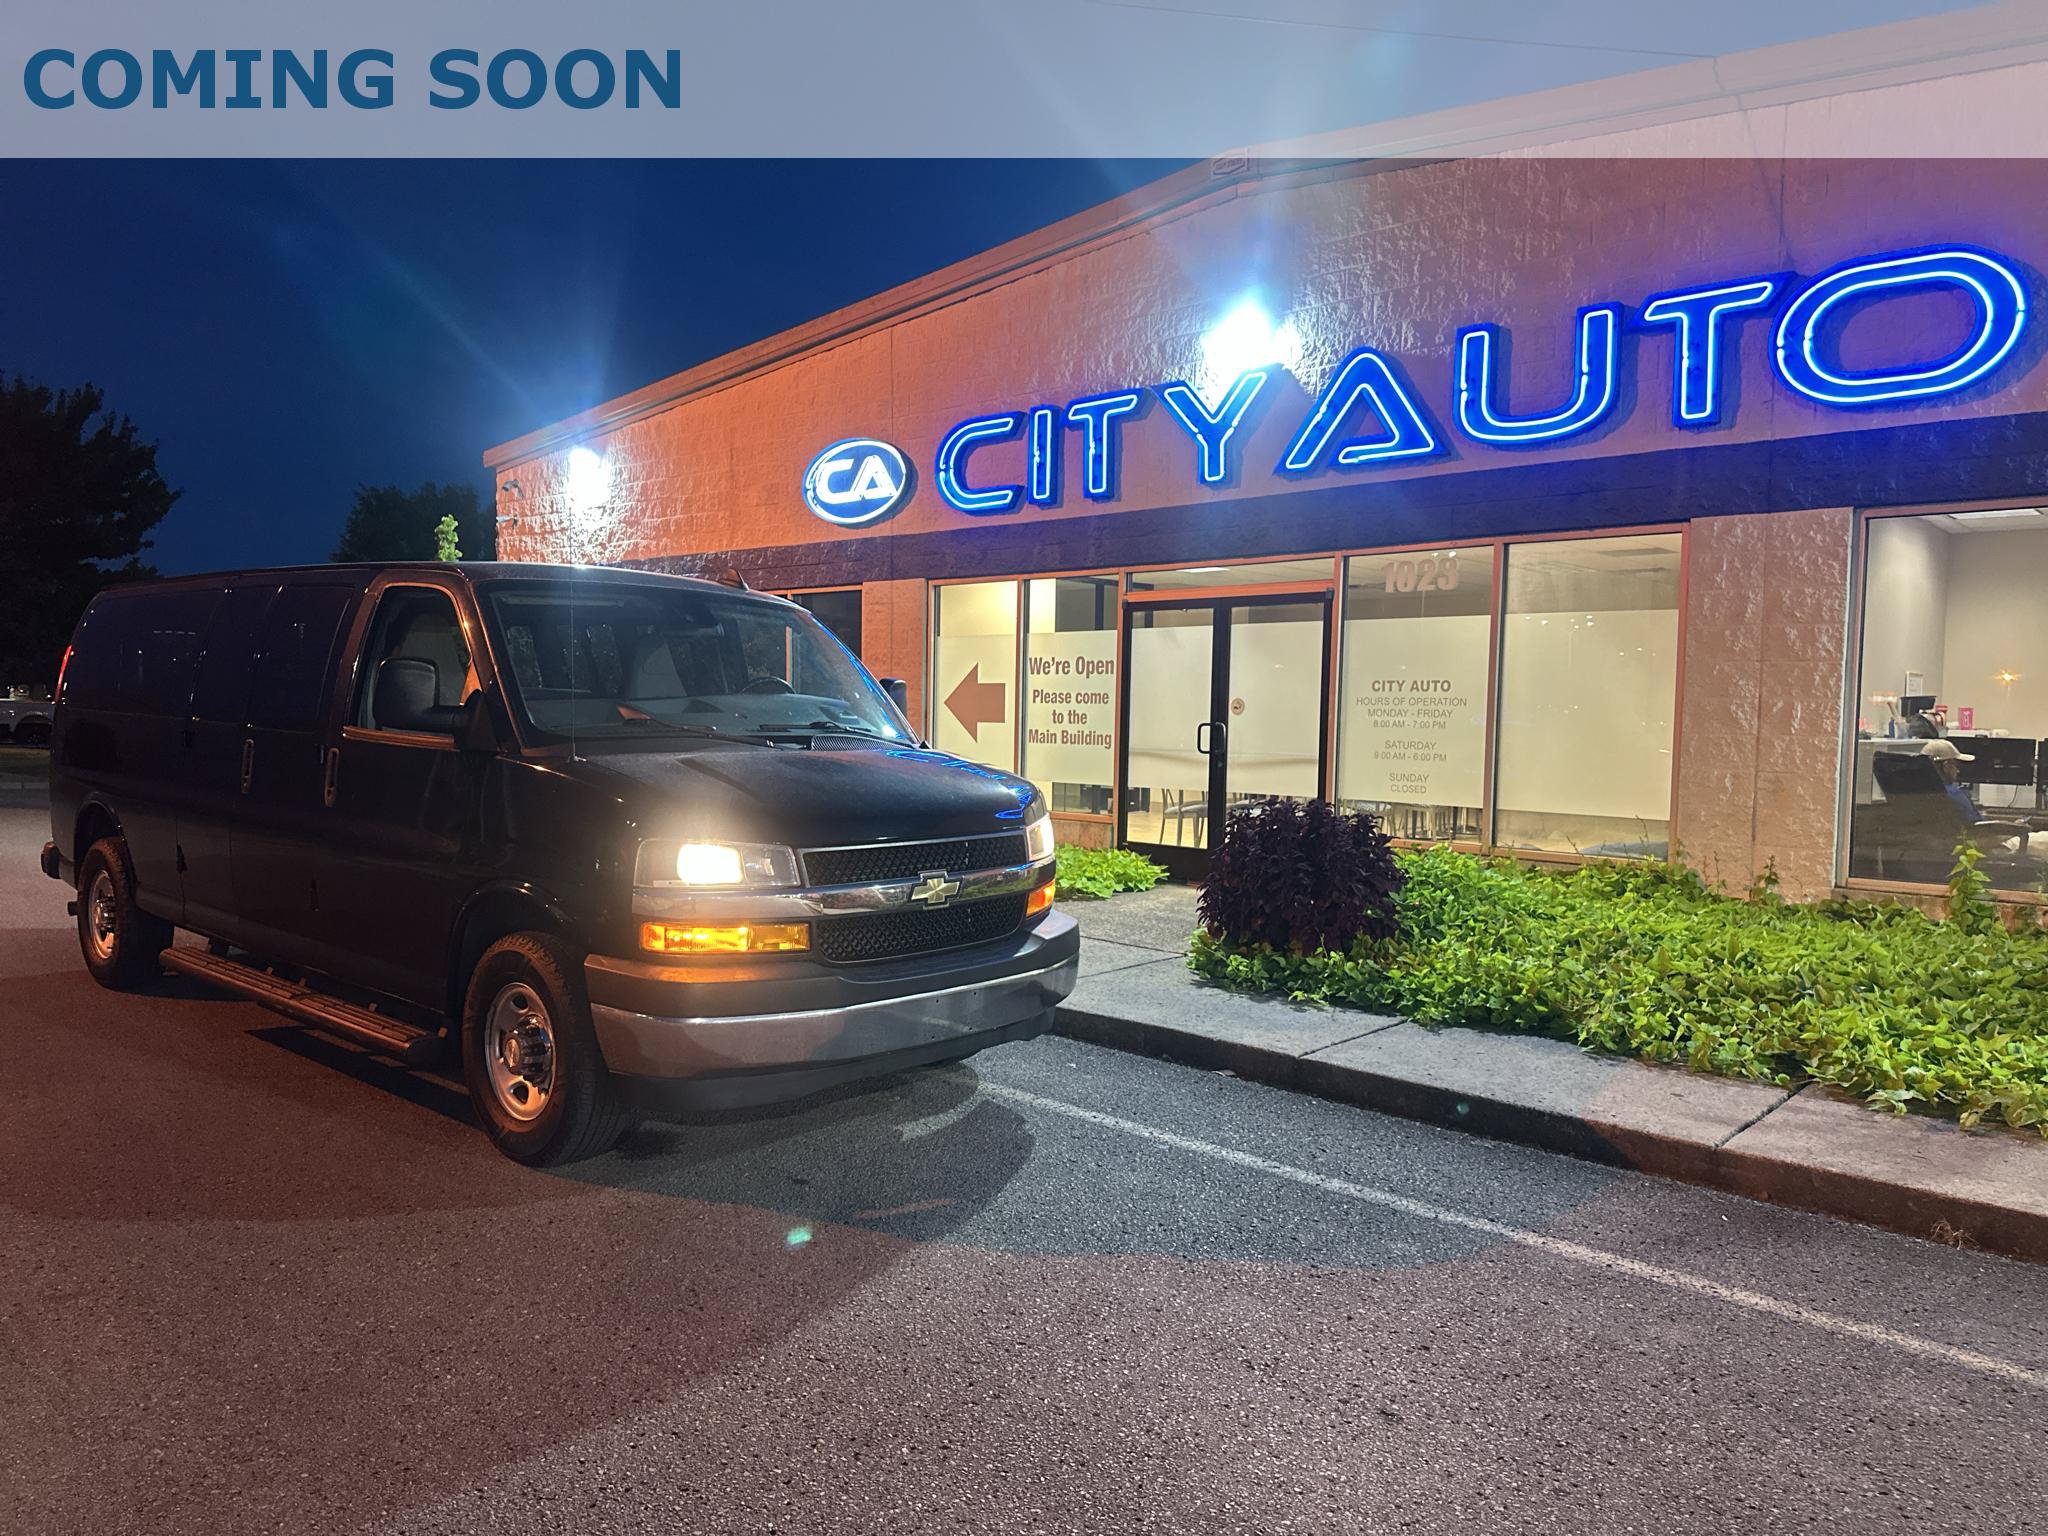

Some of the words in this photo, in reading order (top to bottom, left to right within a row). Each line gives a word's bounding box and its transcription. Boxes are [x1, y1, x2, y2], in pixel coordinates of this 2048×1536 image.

[935, 365, 1275, 517] CITY
[1273, 243, 2030, 478] AUTO
[815, 454, 898, 504] CA
[1029, 657, 1071, 675] We're
[1075, 655, 1115, 679] Open
[1371, 679, 1406, 692] CITY
[1409, 679, 1452, 692] AUTO
[1032, 689, 1072, 704] Please
[1075, 692, 1110, 705] come
[1356, 697, 1391, 706] HOURS
[1392, 697, 1406, 706] OF
[1408, 697, 1468, 707] OPERATION
[1052, 710, 1065, 724] to
[1067, 709, 1088, 725] the
[1367, 708, 1409, 718] MONDAY
[1417, 708, 1454, 719] FRIDAY
[1391, 719, 1405, 729] AM
[1432, 720, 1447, 729] PM
[1028, 729, 1058, 745] Main
[1061, 730, 1112, 750] Building
[1384, 740, 1437, 750] SATURDAY
[1392, 751, 1406, 761] AM
[1432, 753, 1447, 762] PM
[1388, 772, 1430, 783] SUNDAY
[1390, 784, 1427, 794] CLOSED
